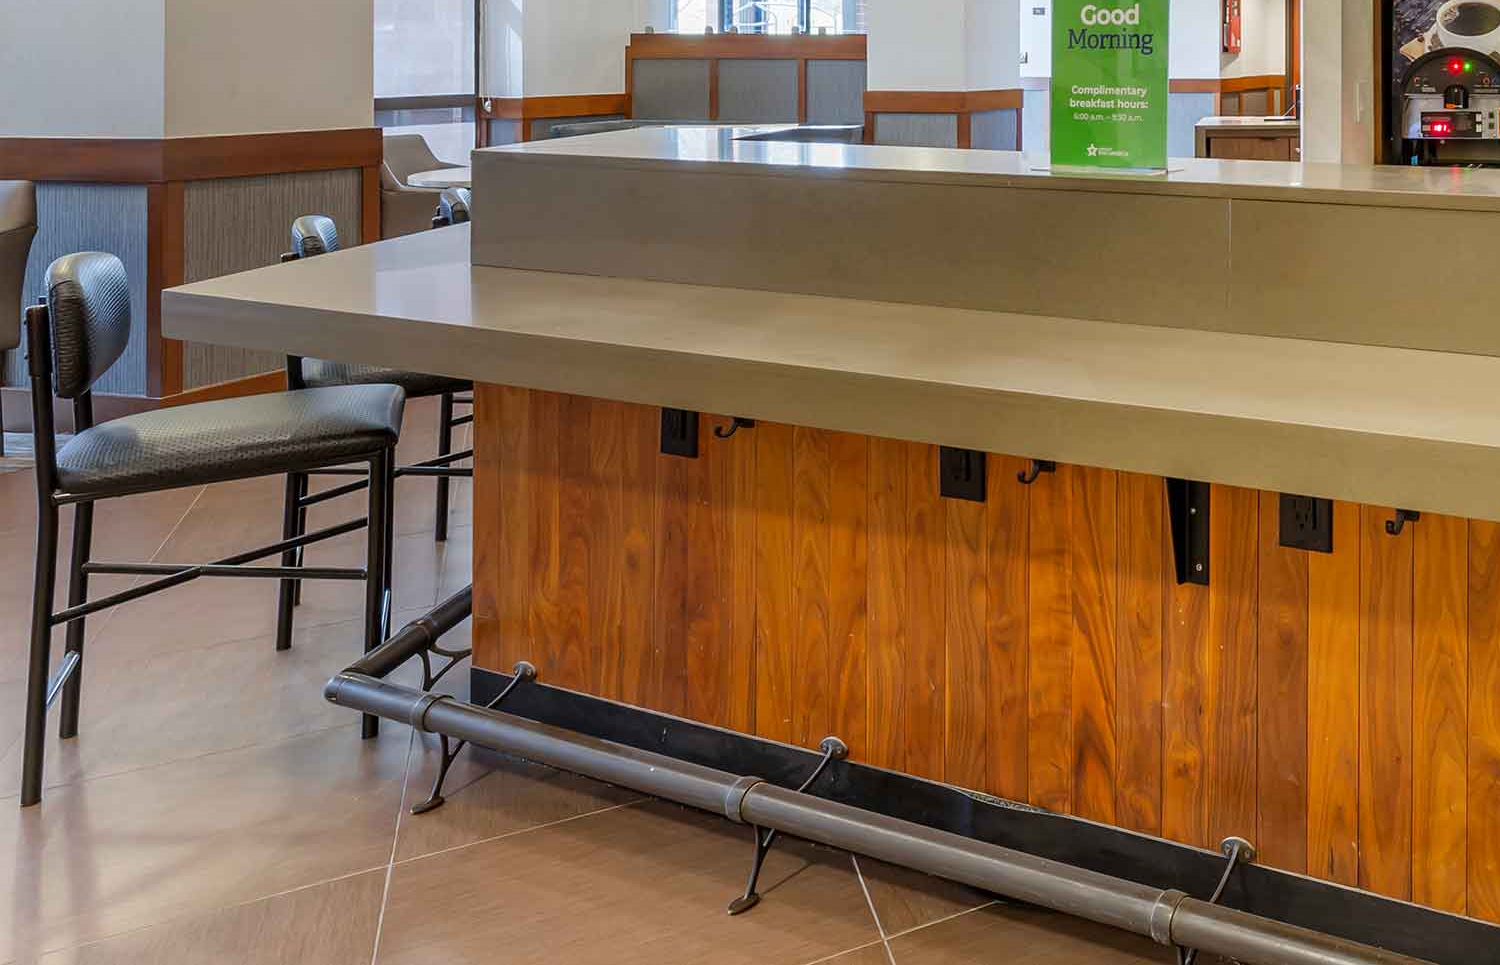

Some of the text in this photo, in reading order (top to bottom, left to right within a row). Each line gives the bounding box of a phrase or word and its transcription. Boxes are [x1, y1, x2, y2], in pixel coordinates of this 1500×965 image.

[1080, 4, 1140, 25] Good
[1067, 28, 1154, 55] Morning
[1071, 85, 1147, 98] Complimentary
[1069, 98, 1149, 109] breakfast hours:
